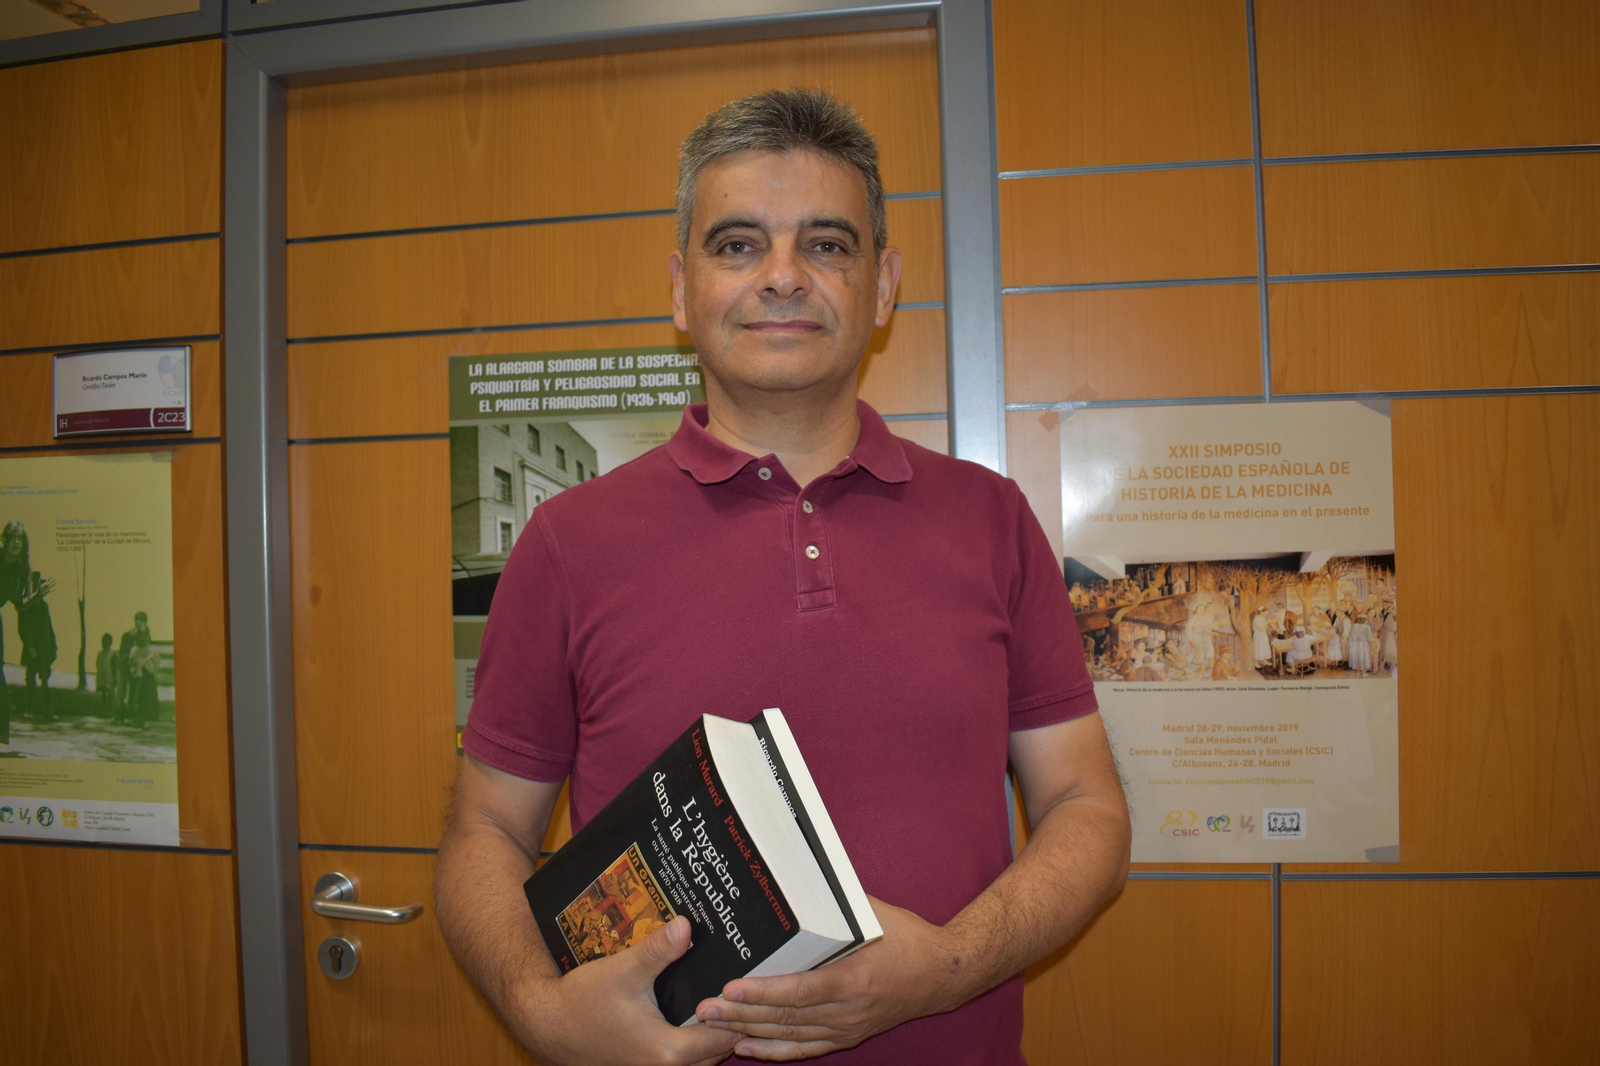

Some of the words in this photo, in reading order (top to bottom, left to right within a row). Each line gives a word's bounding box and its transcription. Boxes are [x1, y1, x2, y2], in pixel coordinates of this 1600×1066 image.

[468, 364, 482, 376] LA
[486, 360, 544, 376] ALARGADA
[547, 358, 598, 372] SOMBRA
[601, 357, 616, 370] DE
[619, 356, 634, 370] LA
[470, 377, 540, 395] PSIQUIATRÍA
[543, 378, 552, 391] Y
[555, 375, 636, 391] PELIGROSIDAD
[640, 373, 682, 387] SOCIAL
[685, 372, 700, 385] EN
[479, 400, 493, 413] EL
[496, 397, 539, 412] PRIMER
[542, 394, 618, 411] FRANQUISMO
[621, 390, 691, 410] (1936-1960)
[1168, 444, 1199, 459] XXII
[1204, 442, 1282, 458] SIMPOSIO
[1128, 467, 1148, 480] LA
[1153, 464, 1233, 480] SOCIEDAD
[1238, 460, 1325, 478] ESPAÑOLA
[1329, 461, 1350, 475] DE
[1121, 486, 1196, 502] HISTORIA
[1201, 486, 1221, 499] DE
[1226, 485, 1247, 499] LA
[1252, 482, 1333, 498] MEDICINA
[1117, 513, 1138, 522] una
[1142, 510, 1188, 521] historia
[1191, 509, 1206, 520] de
[1209, 509, 1220, 519] la
[1224, 507, 1279, 519] medicina
[1282, 508, 1297, 517] en
[1301, 506, 1312, 517] el
[1316, 506, 1370, 519] presente
[1163, 724, 1194, 732] Madrid
[1197, 724, 1225, 733] 28-29,
[1227, 724, 1275, 732] noviembre
[1277, 723, 1299, 732] 2019
[1184, 736, 1203, 744] Sala
[1206, 735, 1252, 744] Menéndez
[1254, 736, 1277, 744] Pidal
[1129, 748, 1159, 756] Centro
[1161, 747, 1172, 756] de
[1174, 747, 1212, 756] Ciencias
[1214, 747, 1256, 755] Humanas
[1259, 749, 1264, 757] y
[1266, 746, 1303, 755] Sociales
[1306, 746, 1334, 755] (CSIC)
[1172, 759, 1225, 768] C/Albasanz,
[1259, 759, 1290, 767] Madrid
[692, 727, 703, 759] Lion
[699, 759, 724, 807] Murard
[724, 815, 752, 861] Patrick
[750, 861, 791, 932] Zylberman
[1172, 828, 1200, 836] CSIC
[682, 796, 740, 900] L'hygiène
[652, 771, 673, 818] dans
[669, 818, 683, 842] la
[681, 841, 752, 960] République
[628, 846, 640, 866] Un
[640, 868, 666, 911] Grand
[651, 818, 658, 832] La
[657, 833, 670, 854] santé
[668, 854, 690, 888] publique
[689, 890, 697, 901] en
[696, 901, 715, 934] France,
[652, 840, 659, 852] ou
[658, 852, 676, 881] l'utopie
[676, 882, 701, 924] contrariée
[659, 868, 682, 905] 1870-1918
[559, 914, 568, 931] LA
